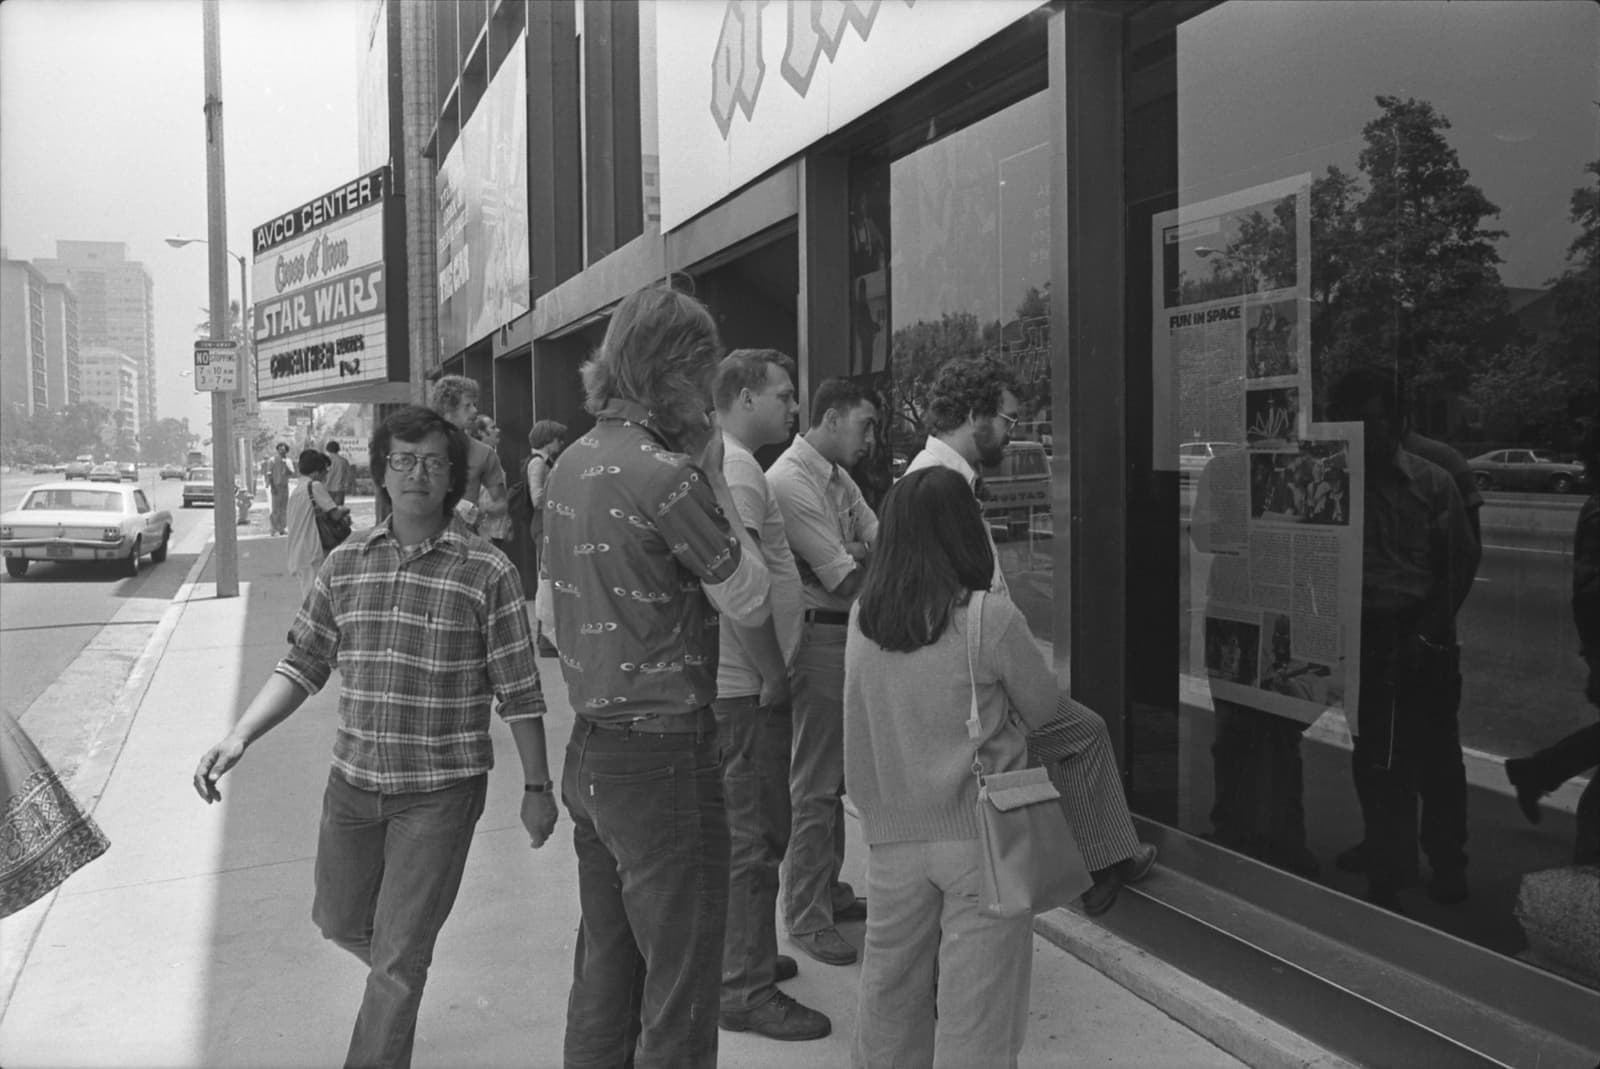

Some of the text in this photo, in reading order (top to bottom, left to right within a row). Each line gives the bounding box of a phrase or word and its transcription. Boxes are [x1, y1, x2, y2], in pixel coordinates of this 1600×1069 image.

[256, 213, 295, 251] AVCO
[301, 176, 372, 233] CENTER
[256, 295, 311, 341] STAR
[315, 270, 382, 324] WARS
[1169, 305, 1241, 329] FUN IN SPACE
[196, 351, 209, 365] NO
